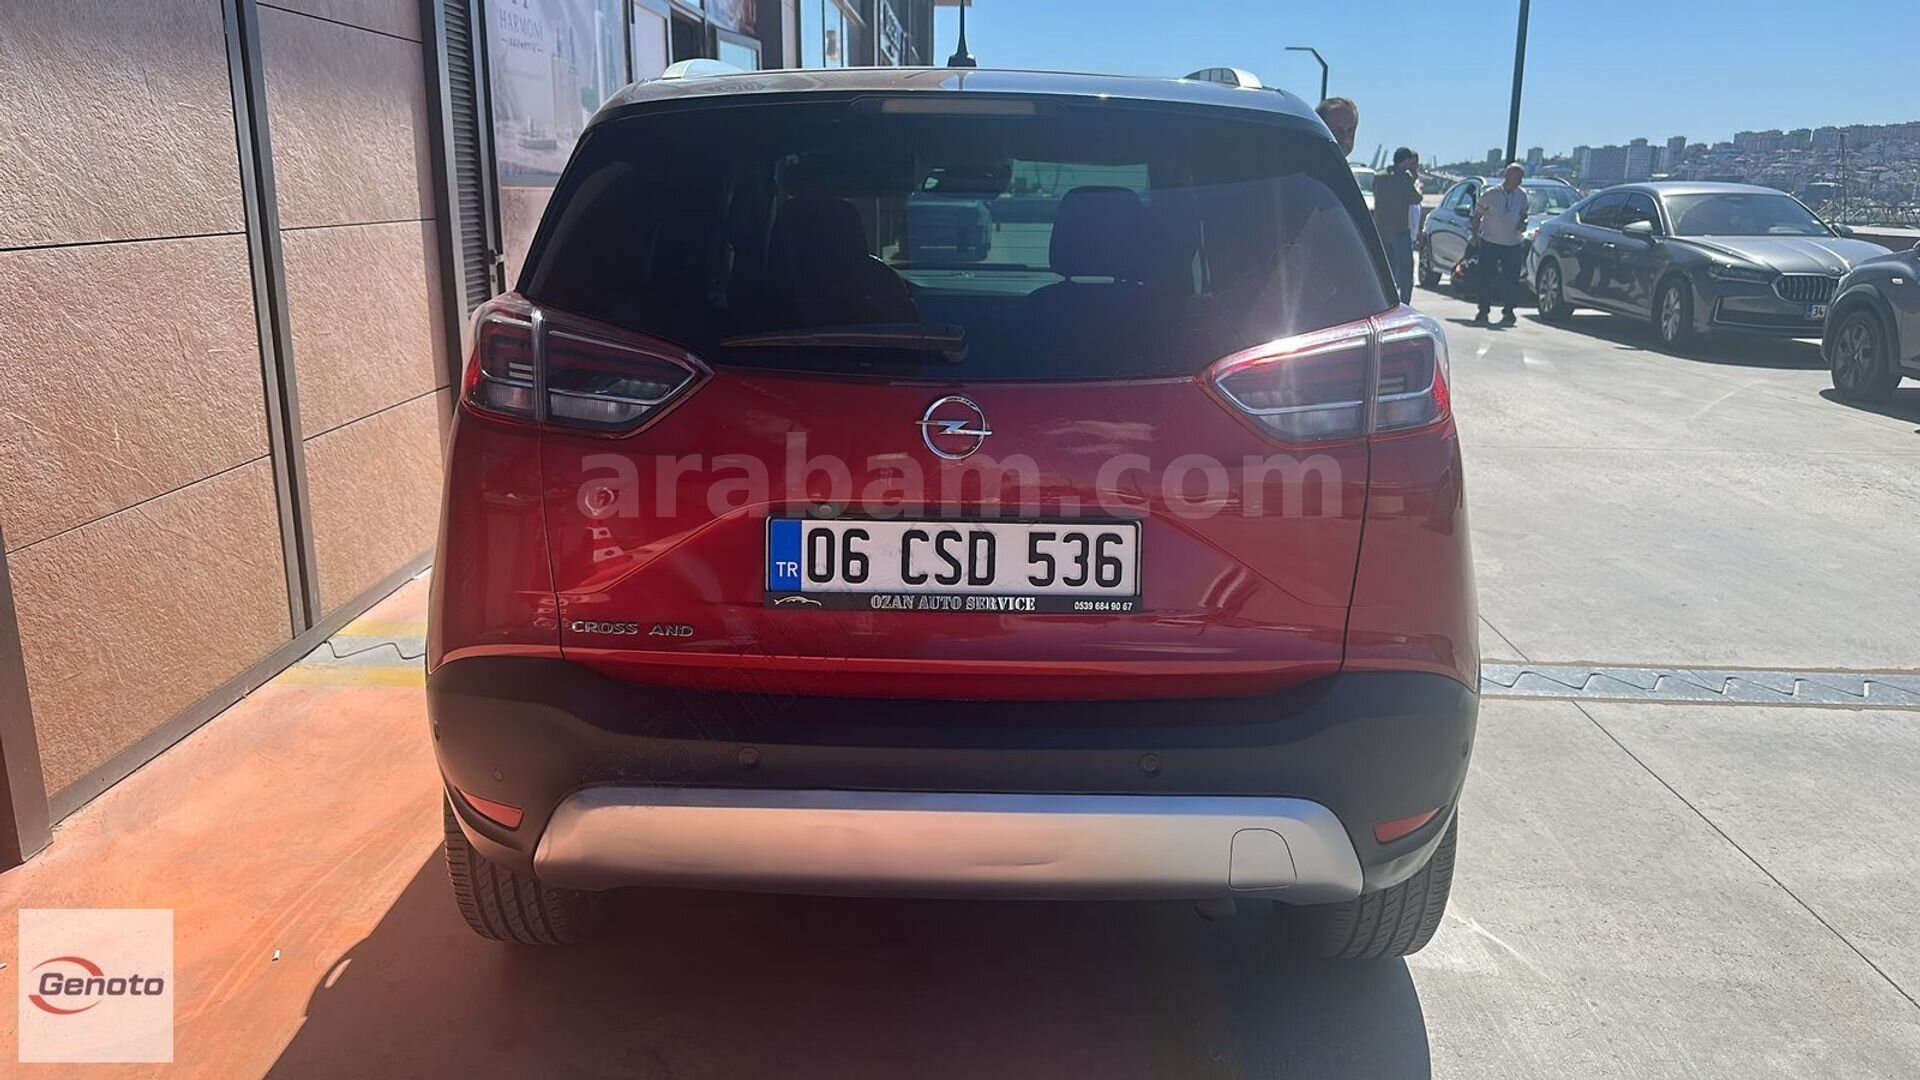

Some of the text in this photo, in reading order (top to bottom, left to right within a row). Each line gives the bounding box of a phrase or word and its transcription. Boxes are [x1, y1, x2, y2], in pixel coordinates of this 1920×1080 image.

[807, 527, 1124, 588] 06 CSD 536
[775, 561, 798, 577] TR
[870, 594, 1036, 612] OZAN AUTO SERVICE
[1074, 601, 1094, 611] 0539
[1095, 601, 1110, 611] 684
[1110, 601, 1121, 611] 90
[571, 620, 695, 638] CROSS AND
